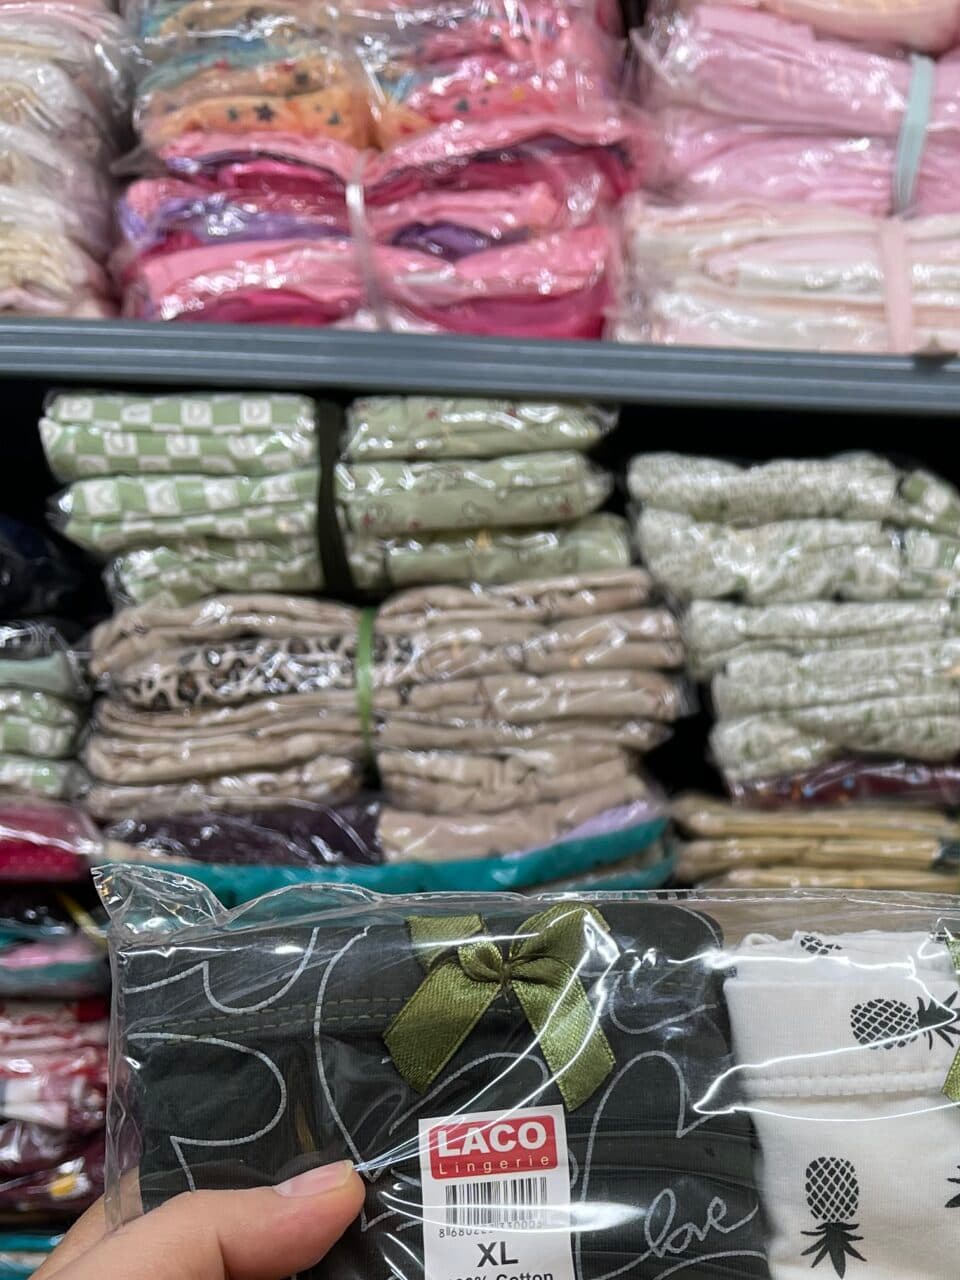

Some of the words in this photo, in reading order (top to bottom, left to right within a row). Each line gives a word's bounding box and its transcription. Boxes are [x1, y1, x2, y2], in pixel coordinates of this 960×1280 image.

[437, 1121, 547, 1158] LACO
[439, 1155, 550, 1175] Lingerie
[644, 1188, 759, 1258] love
[476, 1241, 519, 1268] XL
